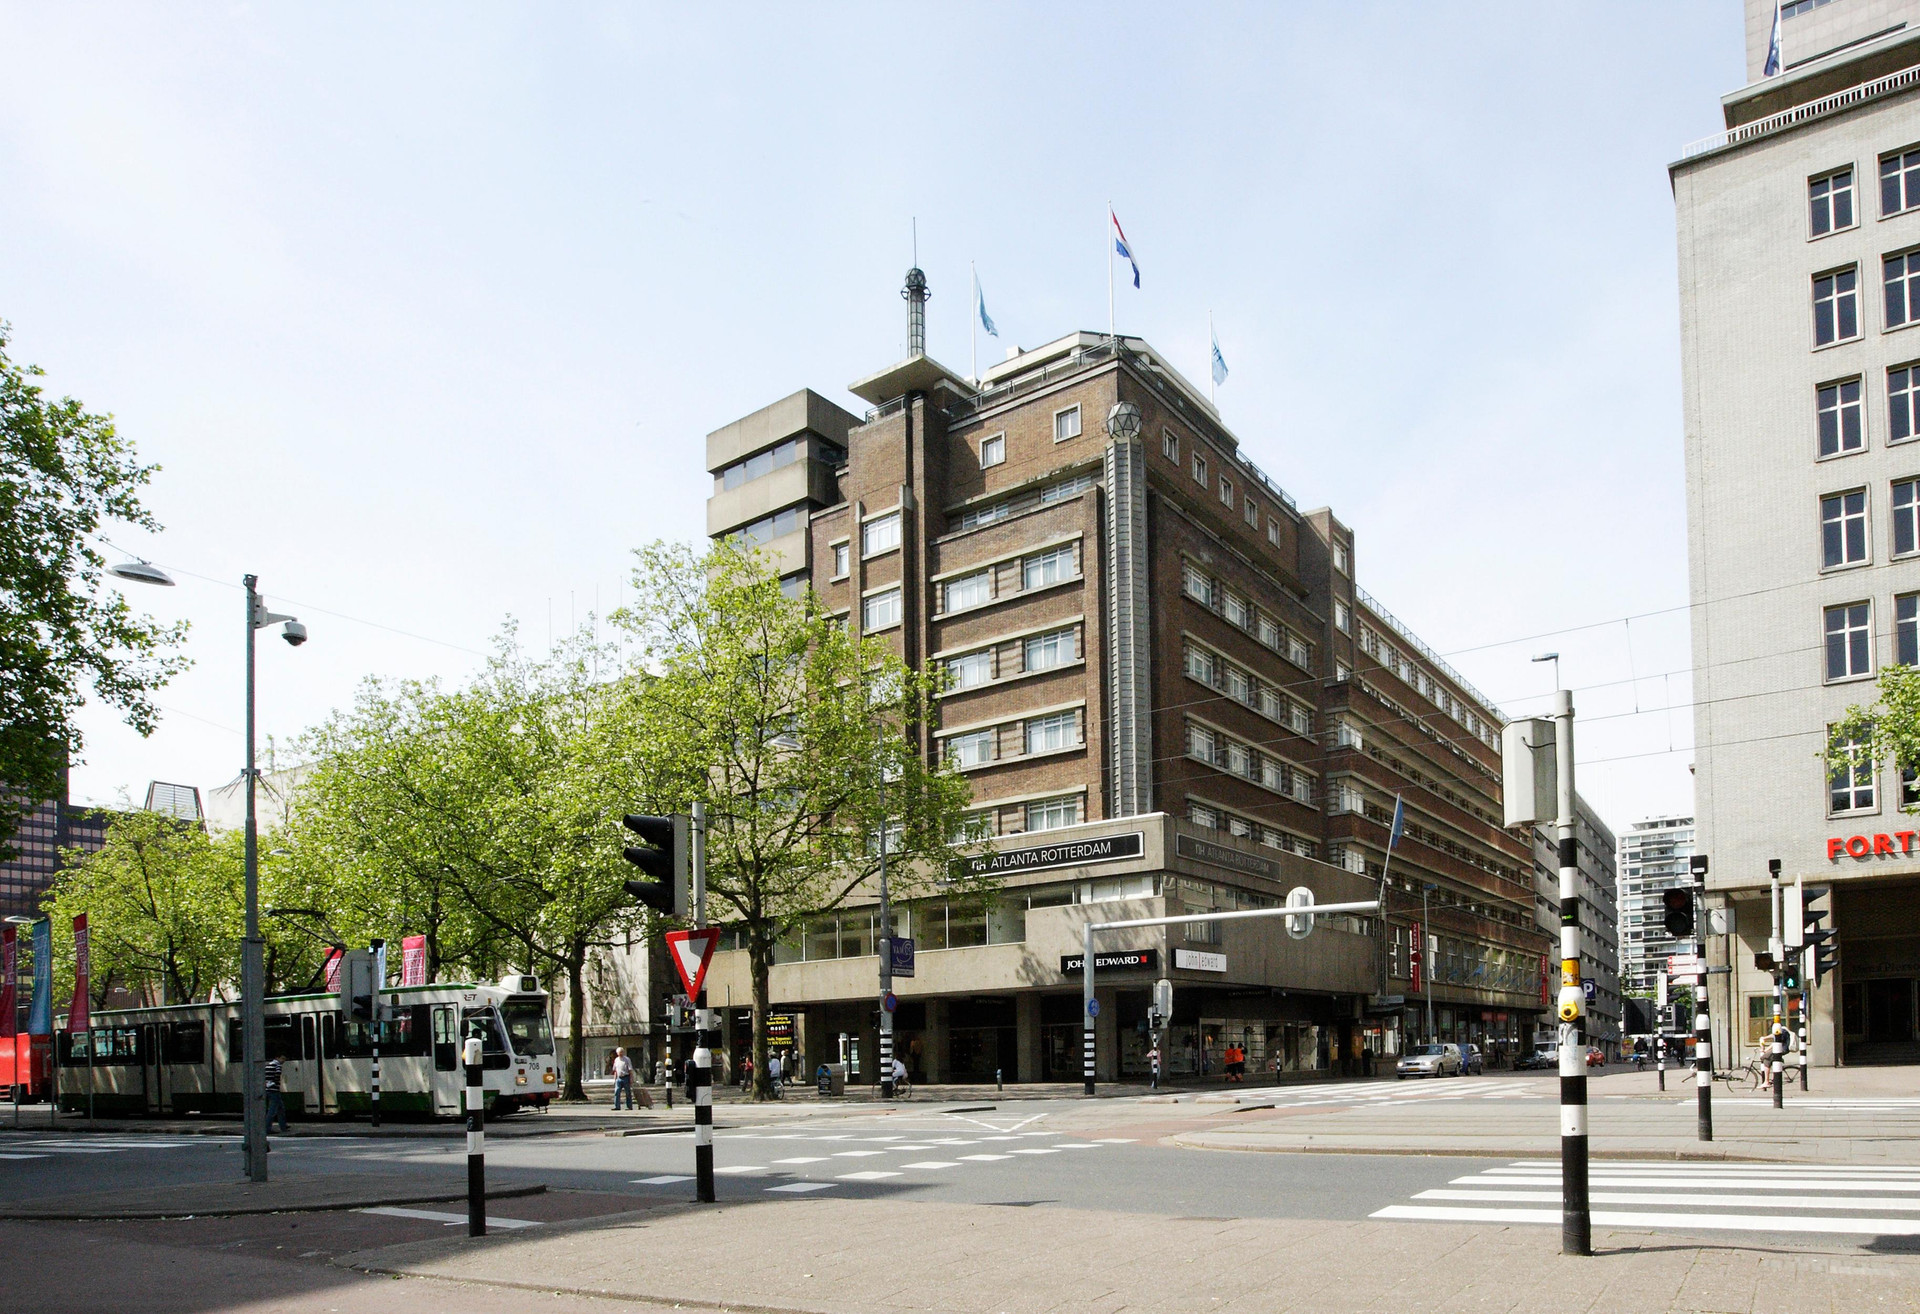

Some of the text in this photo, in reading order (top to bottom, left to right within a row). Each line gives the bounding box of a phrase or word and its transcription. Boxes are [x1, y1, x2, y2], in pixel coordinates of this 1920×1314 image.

[991, 852, 1039, 869] ATLANTA
[1041, 841, 1111, 862] ROTTERDAM
[1827, 830, 1920, 859] FORT
[1207, 847, 1235, 863] ATLANTA
[1235, 855, 1269, 872] ROTTERDAM
[1066, 956, 1139, 970] JOH EDWARD
[1583, 982, 1593, 999] P
[528, 1062, 540, 1071] 708
